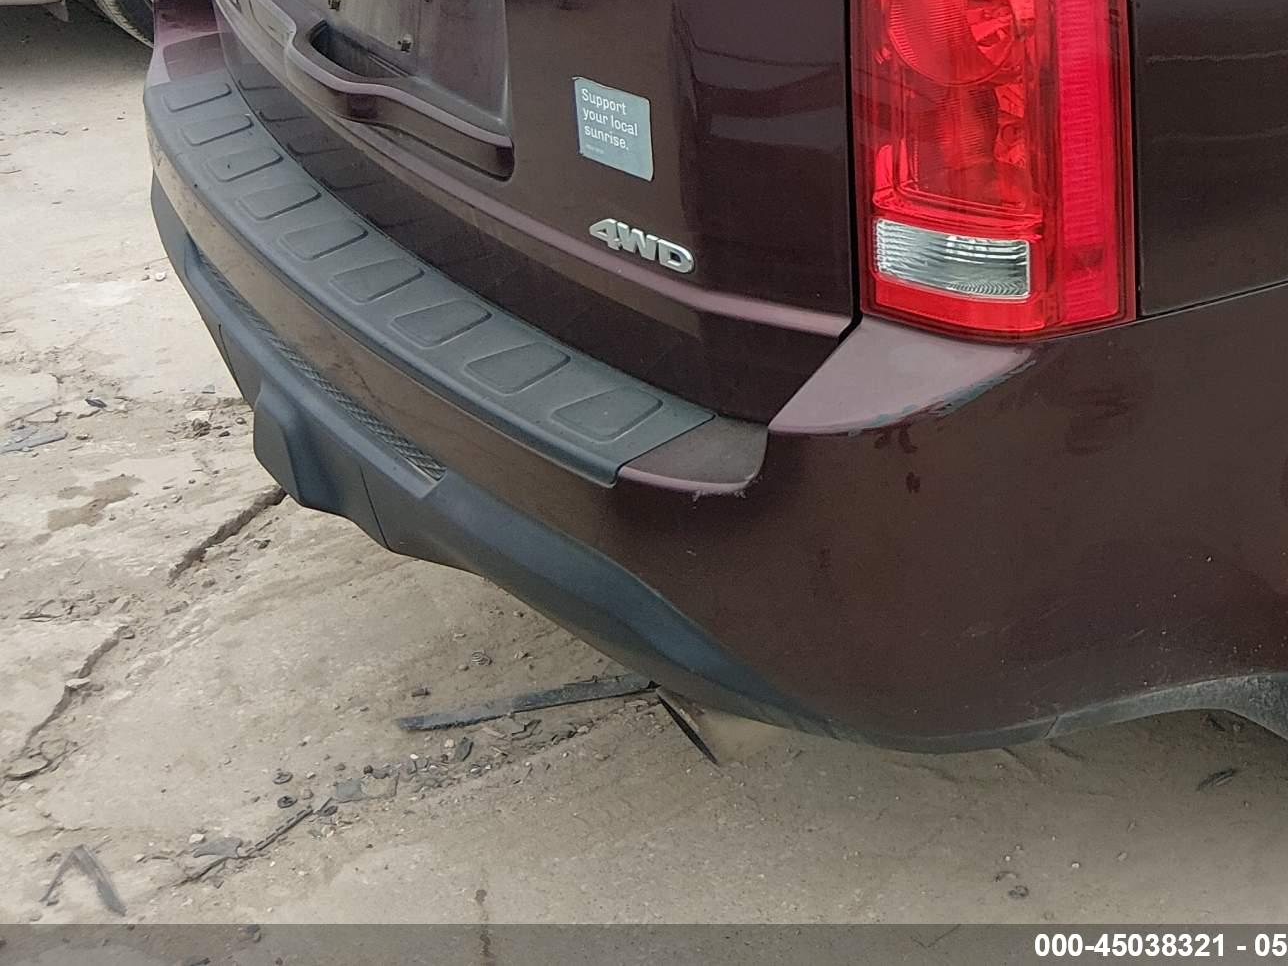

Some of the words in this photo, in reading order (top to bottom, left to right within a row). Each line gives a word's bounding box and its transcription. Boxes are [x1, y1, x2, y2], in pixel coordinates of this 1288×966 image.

[581, 88, 626, 115] Support
[583, 107, 608, 124] your
[611, 115, 638, 136] local
[584, 125, 629, 151] sunrise.
[589, 218, 695, 274] 4WD
